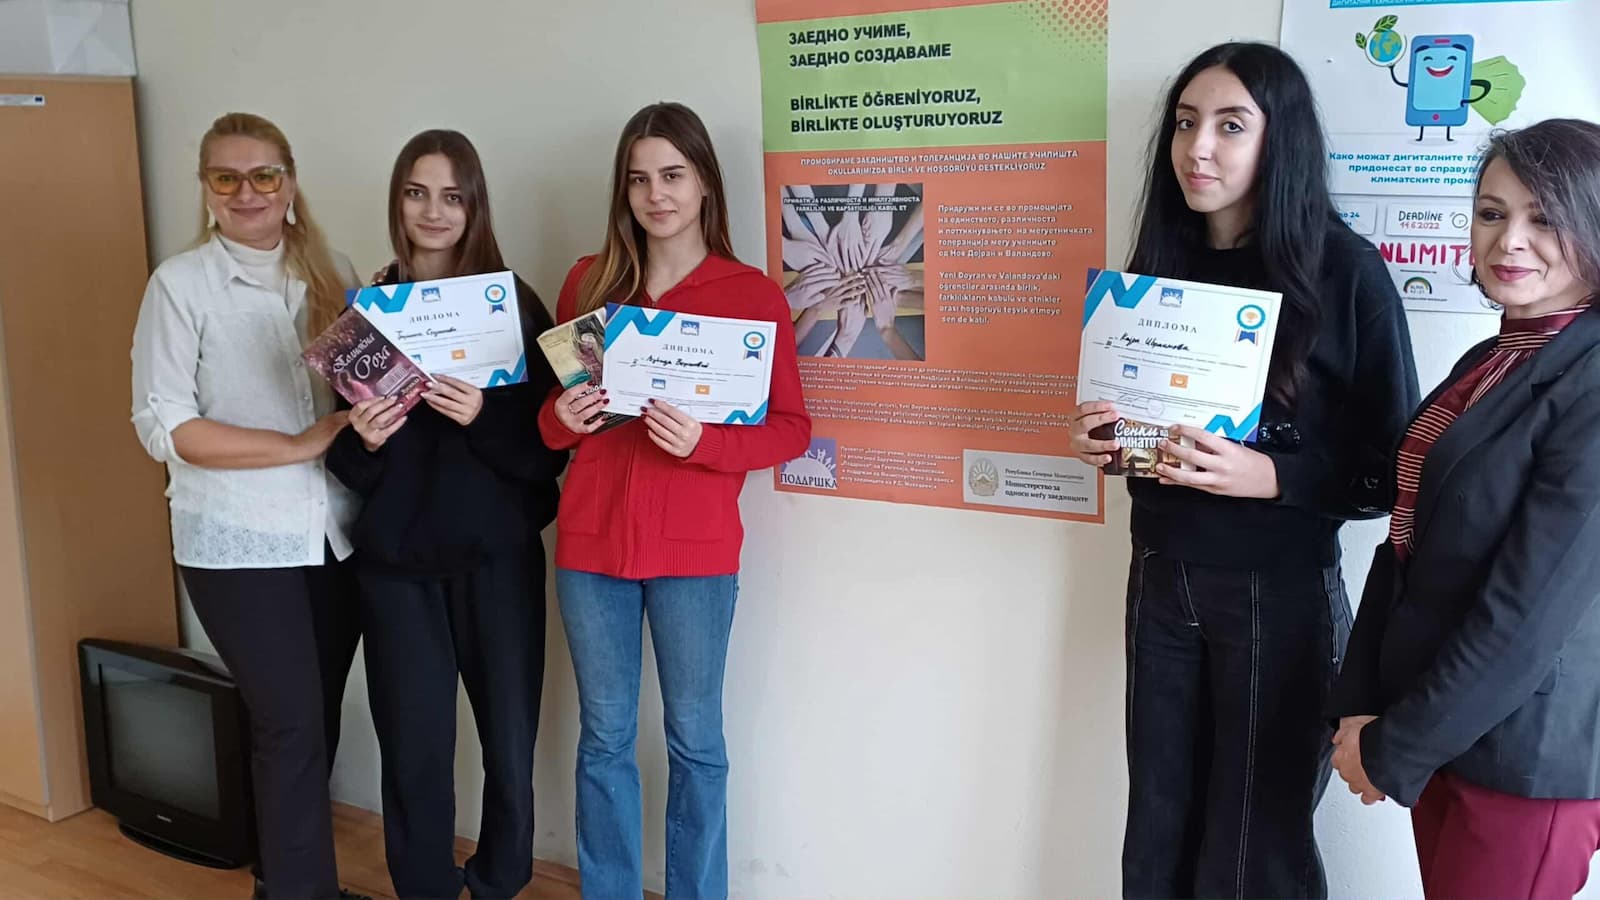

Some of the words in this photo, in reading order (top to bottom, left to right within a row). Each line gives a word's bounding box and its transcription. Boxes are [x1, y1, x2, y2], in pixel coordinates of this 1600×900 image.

[788, 28, 849, 46] ЗАЕДНО
[854, 24, 911, 41] УЧИМЕ,
[789, 50, 850, 69] ЗАЕДНО
[854, 43, 952, 64] СОЗДАВАМЕ
[790, 93, 858, 111] BİRLİKTE
[862, 87, 981, 108] ÖĞRENİYORUZ,
[791, 114, 859, 133] BİRLİKTE
[862, 110, 1003, 132] OLUŞTURUYORUZ
[1329, 152, 1354, 161] Како
[1356, 153, 1390, 161] можат
[1393, 153, 1463, 162] дигиталните
[1349, 164, 1412, 173] придонесат
[1371, 176, 1441, 185] климатските
[1137, 317, 1197, 334] ДИПЛОМА
[661, 343, 714, 355] ДИПЛОМА
[1114, 419, 1159, 437] Сенки
